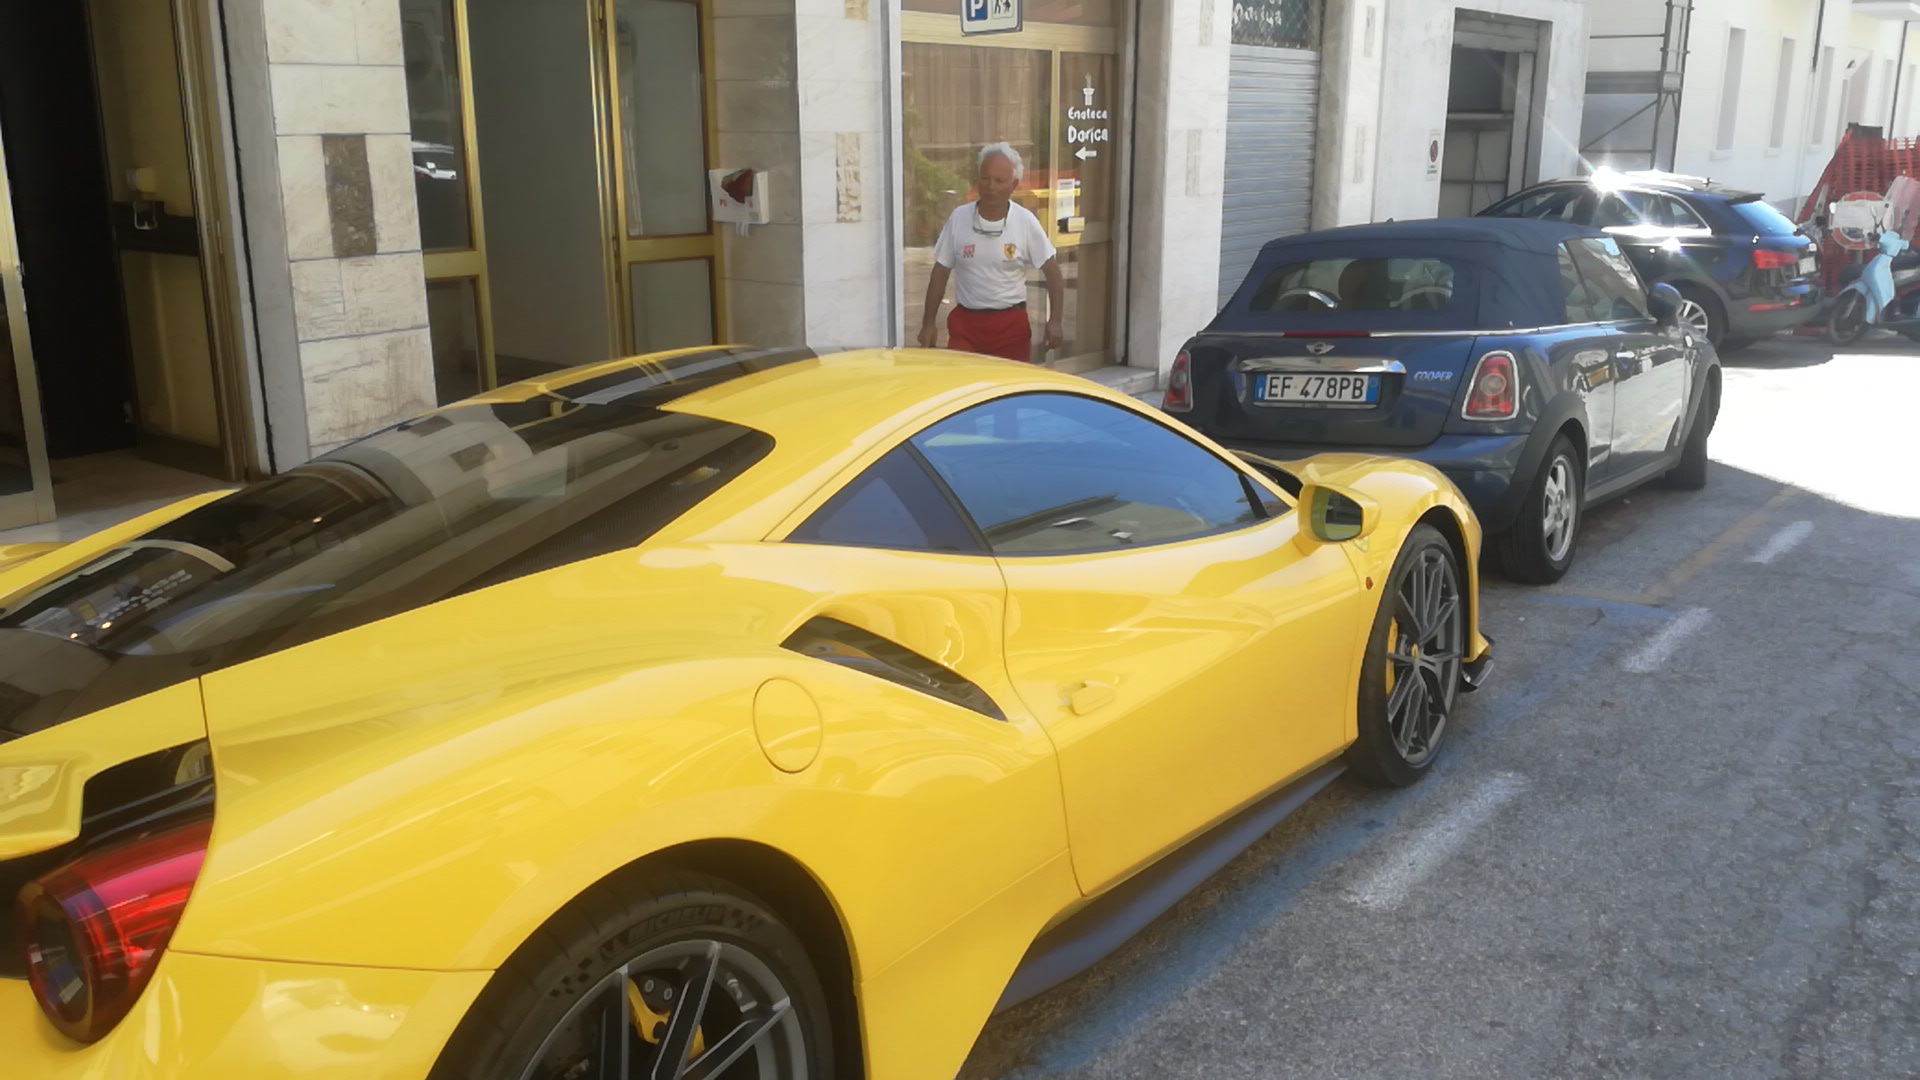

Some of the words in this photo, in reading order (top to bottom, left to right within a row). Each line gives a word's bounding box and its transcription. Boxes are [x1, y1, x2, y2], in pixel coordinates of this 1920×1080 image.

[971, 0, 983, 18] P
[1067, 106, 1108, 120] Enoteca
[1067, 125, 1109, 144] Dorica
[1413, 371, 1454, 382] COOPER
[1267, 376, 1293, 398] EF
[1299, 377, 1366, 400] 478PB
[627, 904, 726, 944] MICHELIN
